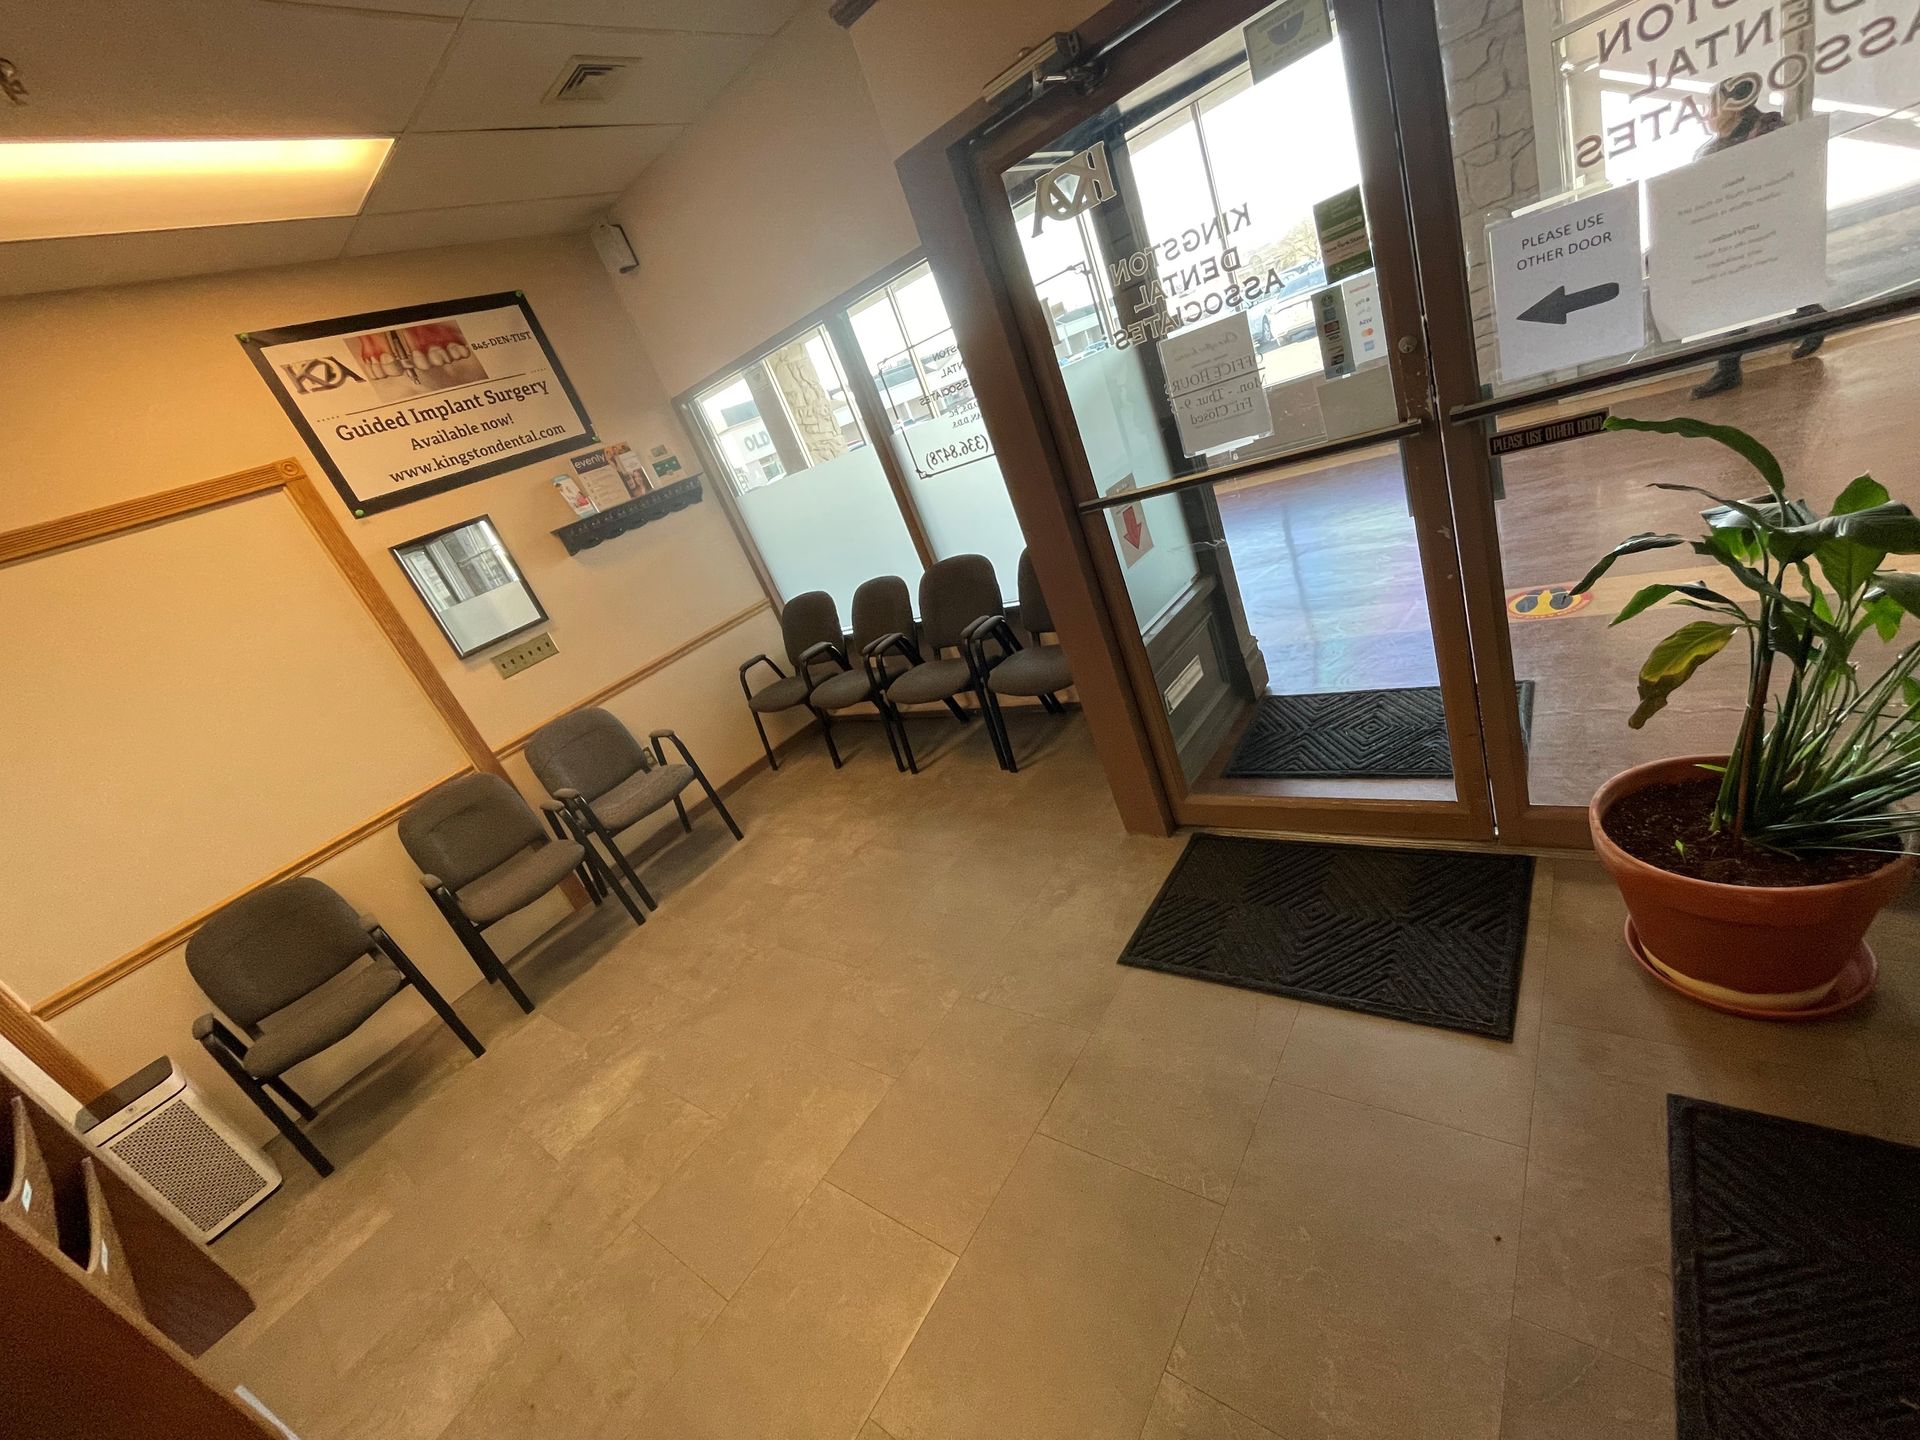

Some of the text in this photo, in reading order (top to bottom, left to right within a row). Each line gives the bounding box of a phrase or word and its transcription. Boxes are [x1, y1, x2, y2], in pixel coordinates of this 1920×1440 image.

[1521, 213, 1605, 250] PLEASE USE
[1516, 231, 1613, 271] OTHER DOOR
[471, 331, 533, 351] 845-DEN-TIST
[335, 378, 551, 442] Guided Implant Surgery
[410, 412, 515, 451] Available now!
[1493, 432, 1525, 453] PLEASE
[1526, 427, 1543, 446] USE
[1545, 422, 1576, 441] OTHER
[388, 422, 567, 484] www.kingstondental.com
[574, 453, 606, 470] evenly
